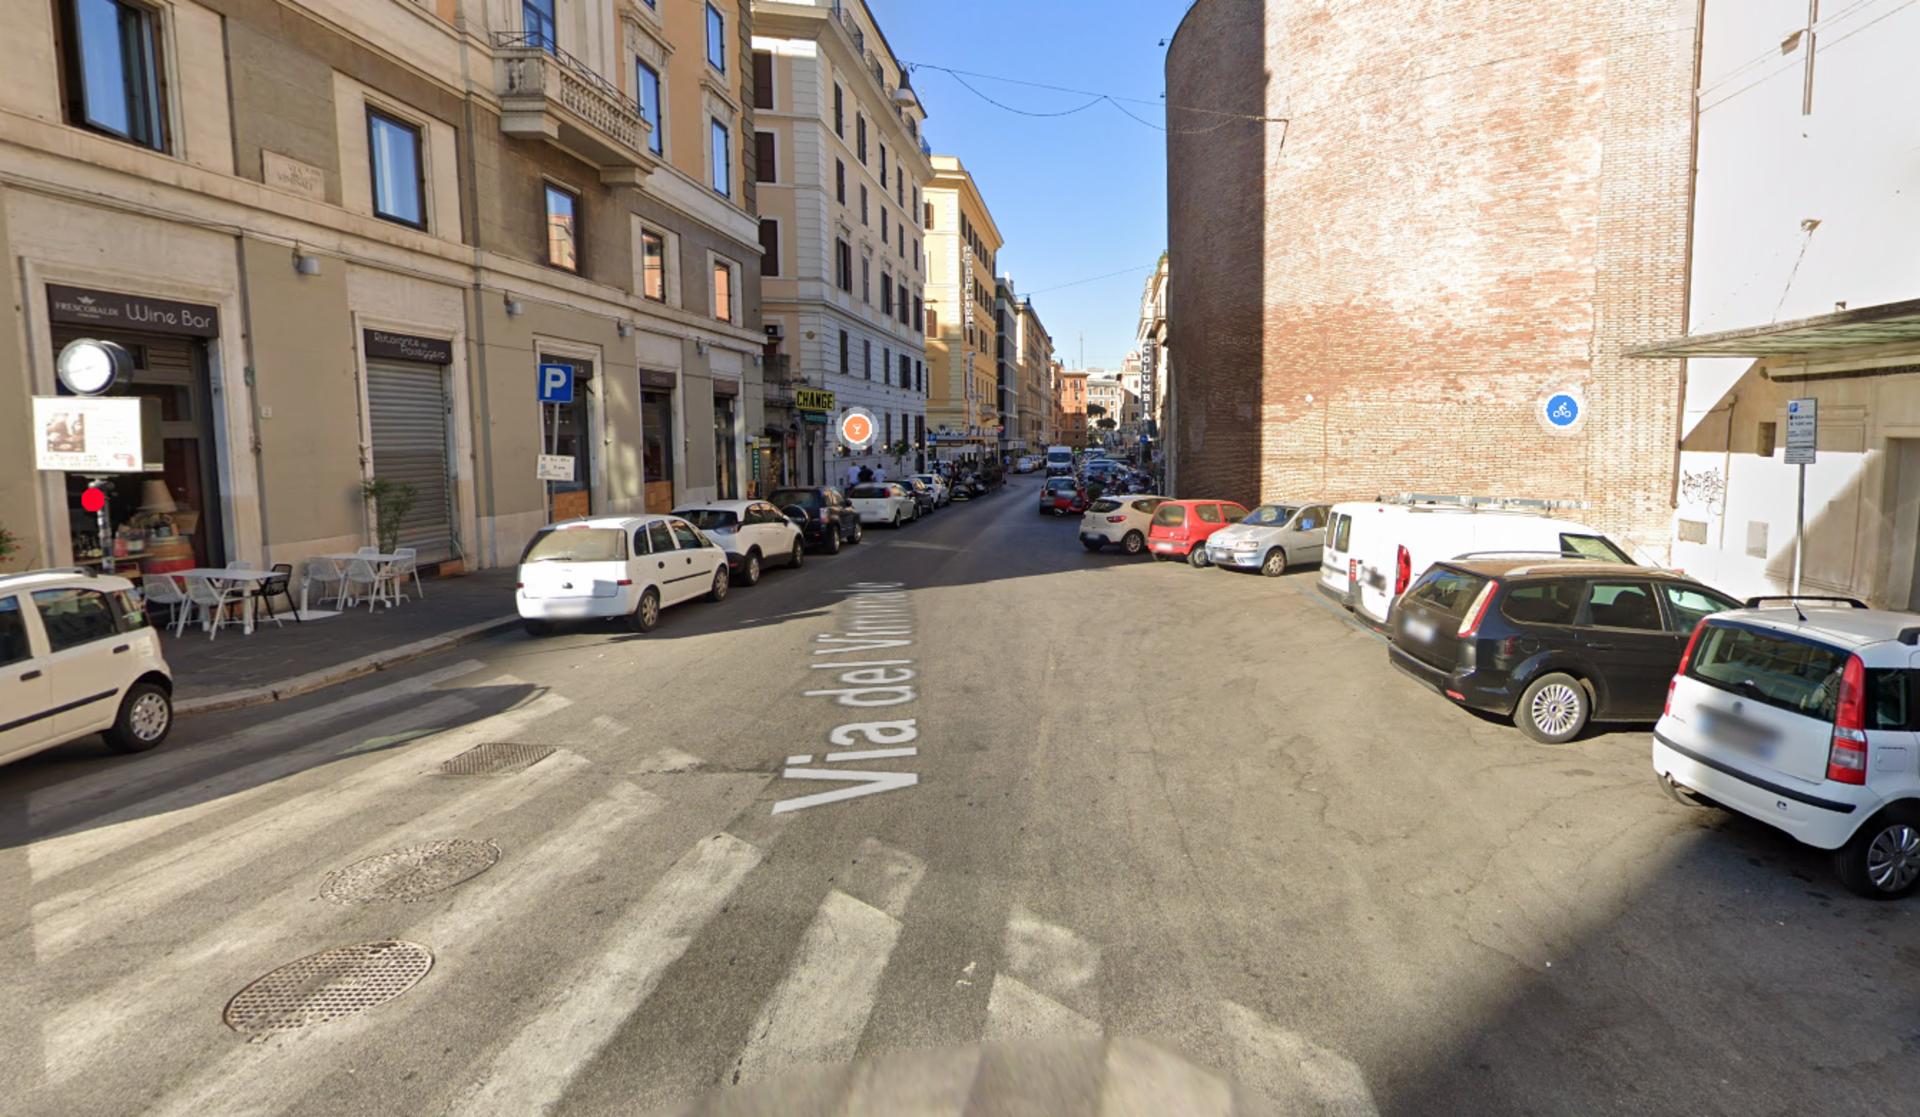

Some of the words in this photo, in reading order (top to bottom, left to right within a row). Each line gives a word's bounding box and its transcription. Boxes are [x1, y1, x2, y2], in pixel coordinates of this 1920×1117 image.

[55, 301, 119, 317] FRESCOBALDI
[126, 303, 177, 325] Wine
[181, 309, 211, 329] Bar
[543, 367, 567, 398] P
[1142, 345, 1151, 420] COLUMBIA
[796, 391, 833, 409] CHANGE
